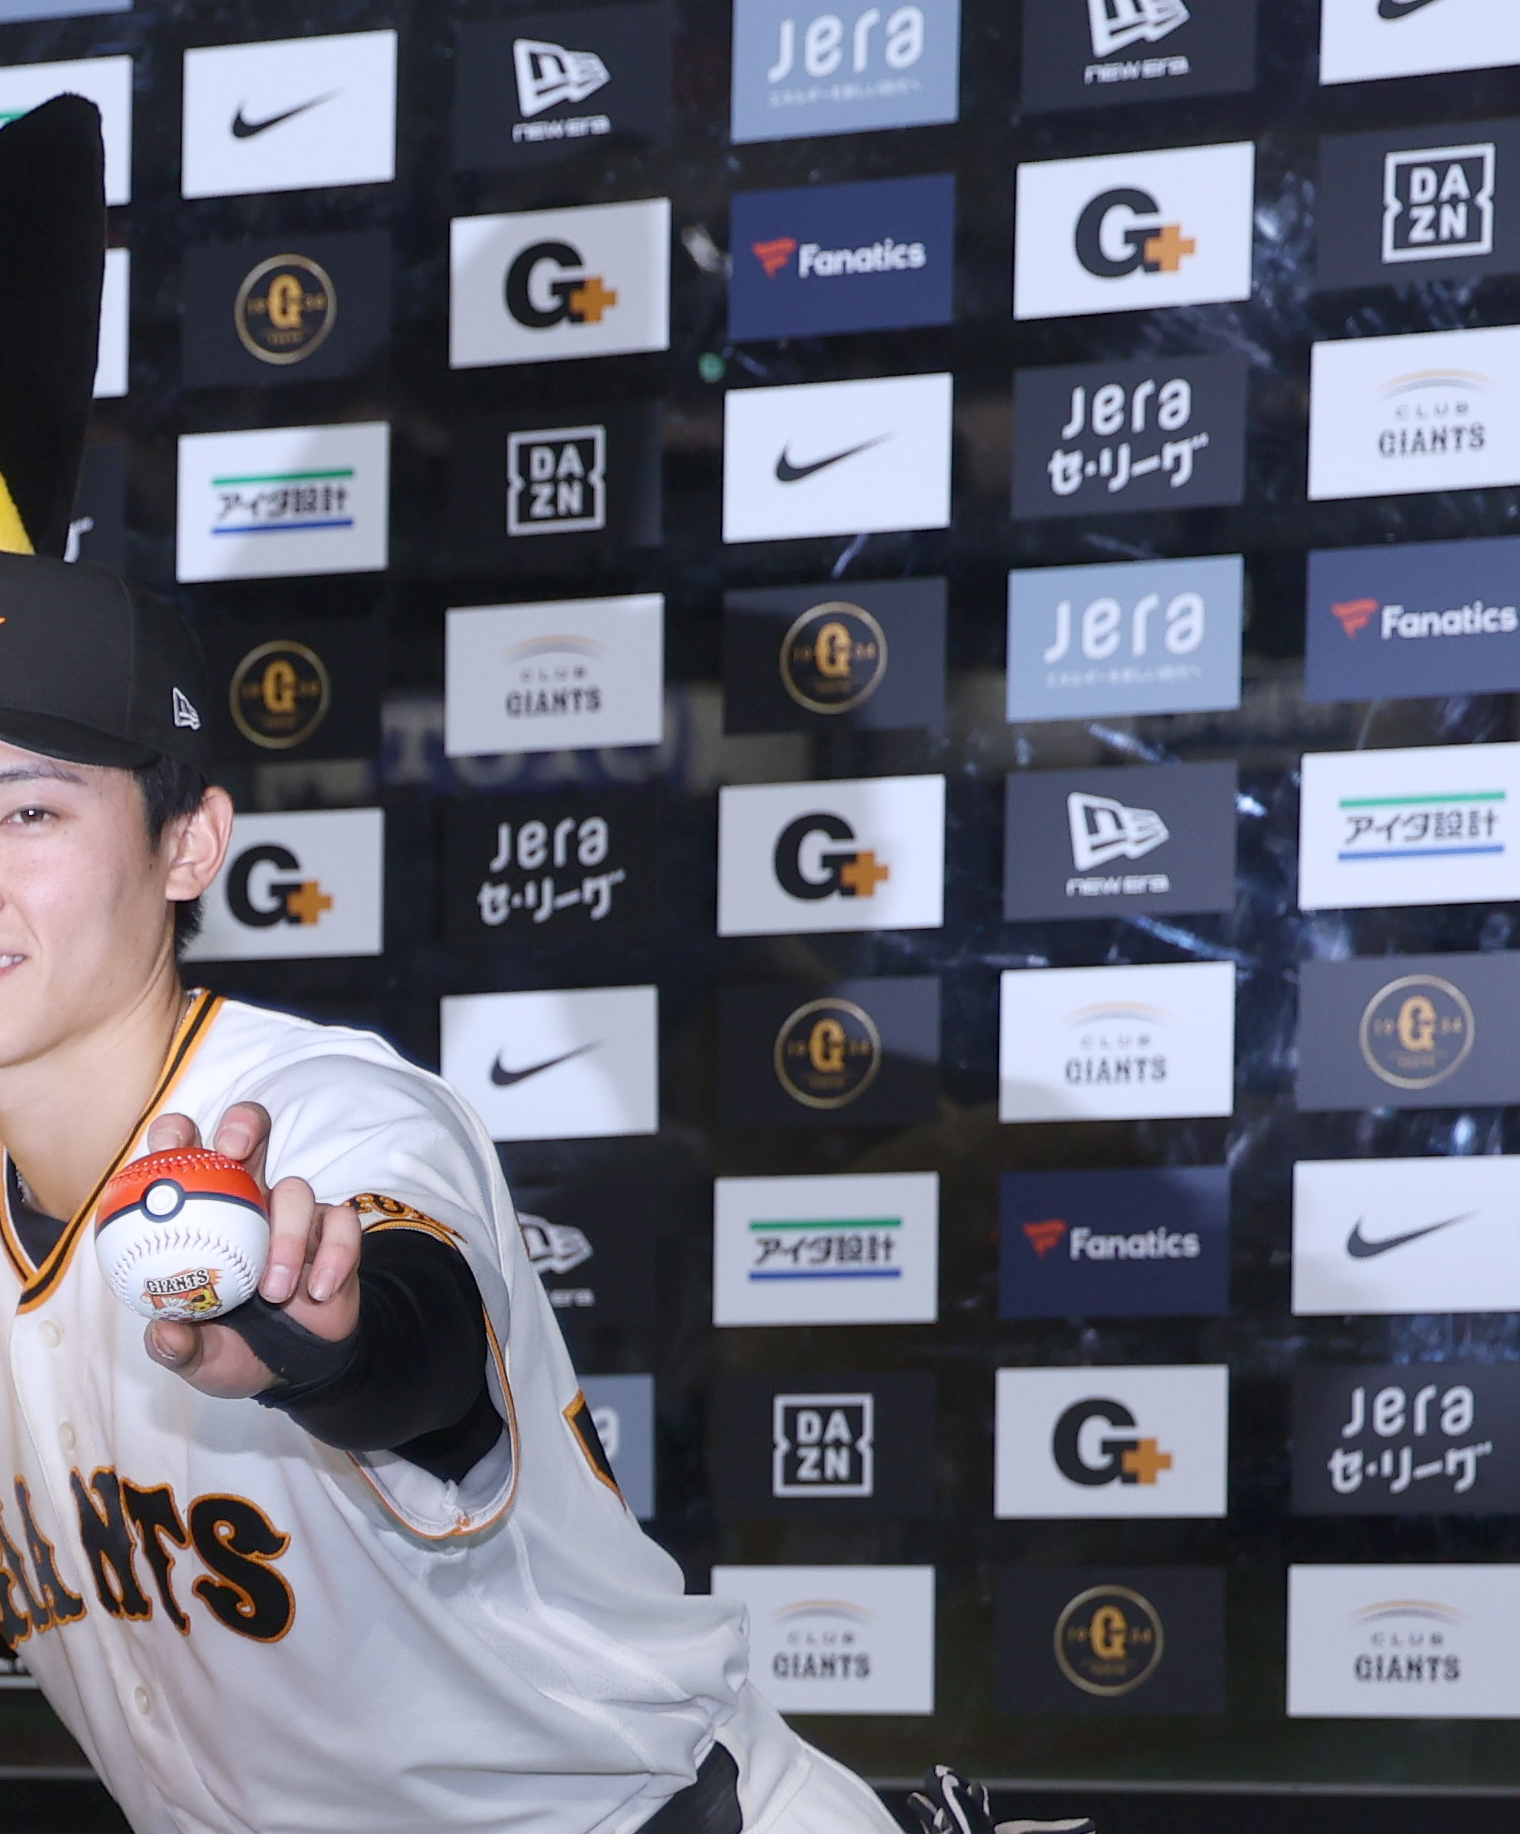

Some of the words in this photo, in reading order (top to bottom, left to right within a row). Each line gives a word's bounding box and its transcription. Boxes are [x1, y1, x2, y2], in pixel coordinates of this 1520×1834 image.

[799, 238, 926, 277] Fanatics
[1378, 425, 1485, 457] GIANTS
[1382, 601, 1518, 638] Fanatics
[506, 688, 601, 716] GIANTS
[1344, 808, 1499, 845] アイダ設計
[1065, 1057, 1166, 1084] GIANTS
[757, 1235, 893, 1264] アイダ設計
[1070, 1227, 1200, 1259] Fanatics
[145, 1266, 210, 1296] GIANTS
[773, 1653, 870, 1678] GIANTS
[1355, 1655, 1459, 1681] GIANTS
